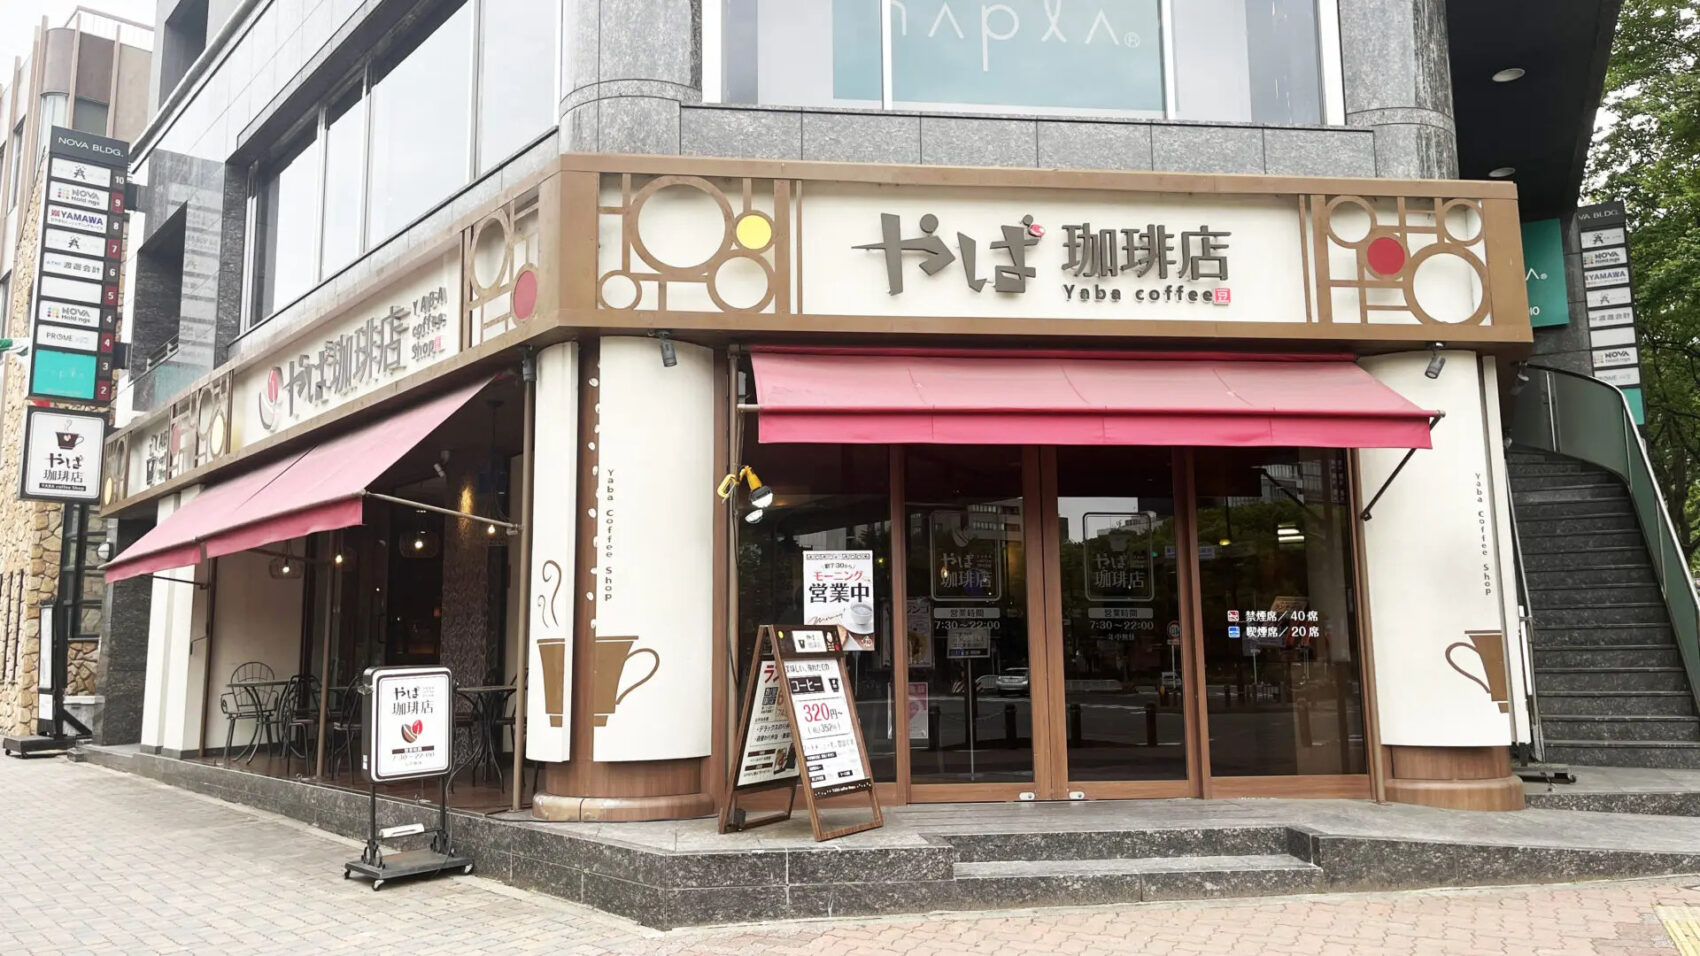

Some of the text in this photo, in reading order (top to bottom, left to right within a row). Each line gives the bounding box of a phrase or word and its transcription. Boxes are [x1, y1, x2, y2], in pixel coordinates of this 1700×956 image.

[58, 137, 124, 157] NOVA BLDG.
[115, 176, 125, 185] 10
[72, 189, 100, 201] NOVA
[115, 199, 121, 207] 9
[61, 211, 104, 225] YAMAWA
[113, 222, 119, 230] 8
[112, 245, 118, 253] 7
[1595, 251, 1619, 260] NOVA
[109, 268, 116, 277] 6
[1590, 270, 1626, 280] YAMAWA
[108, 291, 114, 300] 5
[1063, 284, 1213, 302] Yaba coffee
[413, 287, 447, 315] YABA
[62, 307, 90, 318] NOVA
[106, 315, 112, 323] 4
[412, 313, 447, 338] coffee
[104, 338, 110, 347] 4
[102, 362, 109, 371] 3
[100, 386, 107, 395] 2
[43, 469, 84, 484] 珈琲店
[605, 509, 614, 558] Coffee
[1475, 472, 1491, 596] Yaba Coffee Shop
[814, 570, 863, 582] モーニング
[940, 569, 992, 589] 珈琲店
[1095, 569, 1145, 589] 珈琲店
[604, 566, 613, 602] Shop
[809, 582, 870, 603] 営業中
[950, 608, 984, 618] 営業時間
[1104, 608, 1138, 618] 営業時間
[791, 678, 821, 692] コーヒー
[392, 700, 434, 716] 珈琲店
